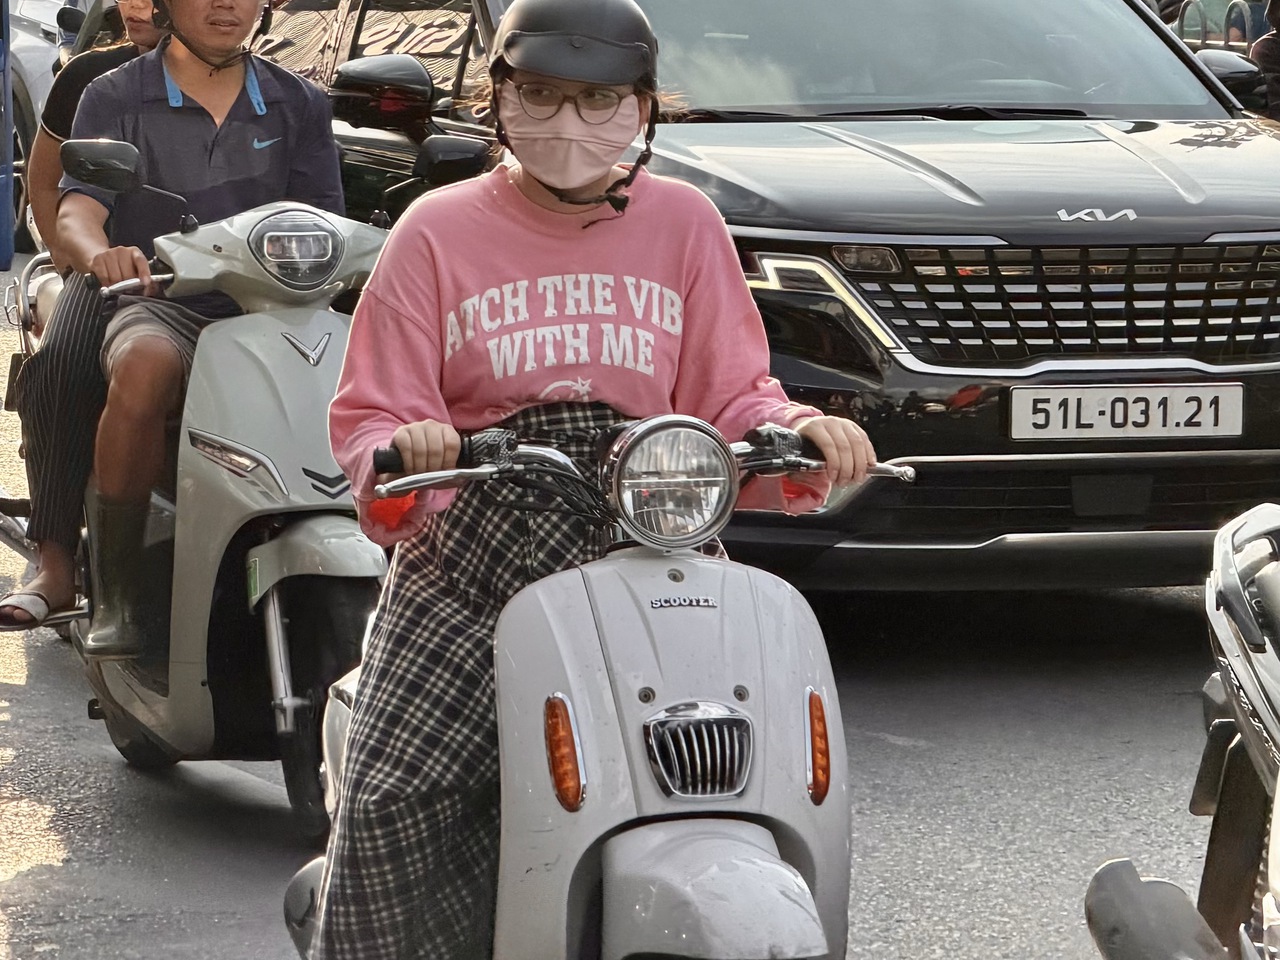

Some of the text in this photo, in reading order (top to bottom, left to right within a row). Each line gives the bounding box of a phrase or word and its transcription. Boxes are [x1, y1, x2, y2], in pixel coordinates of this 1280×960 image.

[537, 273, 618, 318] THE
[486, 323, 655, 380] WITH ME
[1032, 396, 1220, 429] 51L-031.21
[651, 595, 718, 608] SCOOTER
